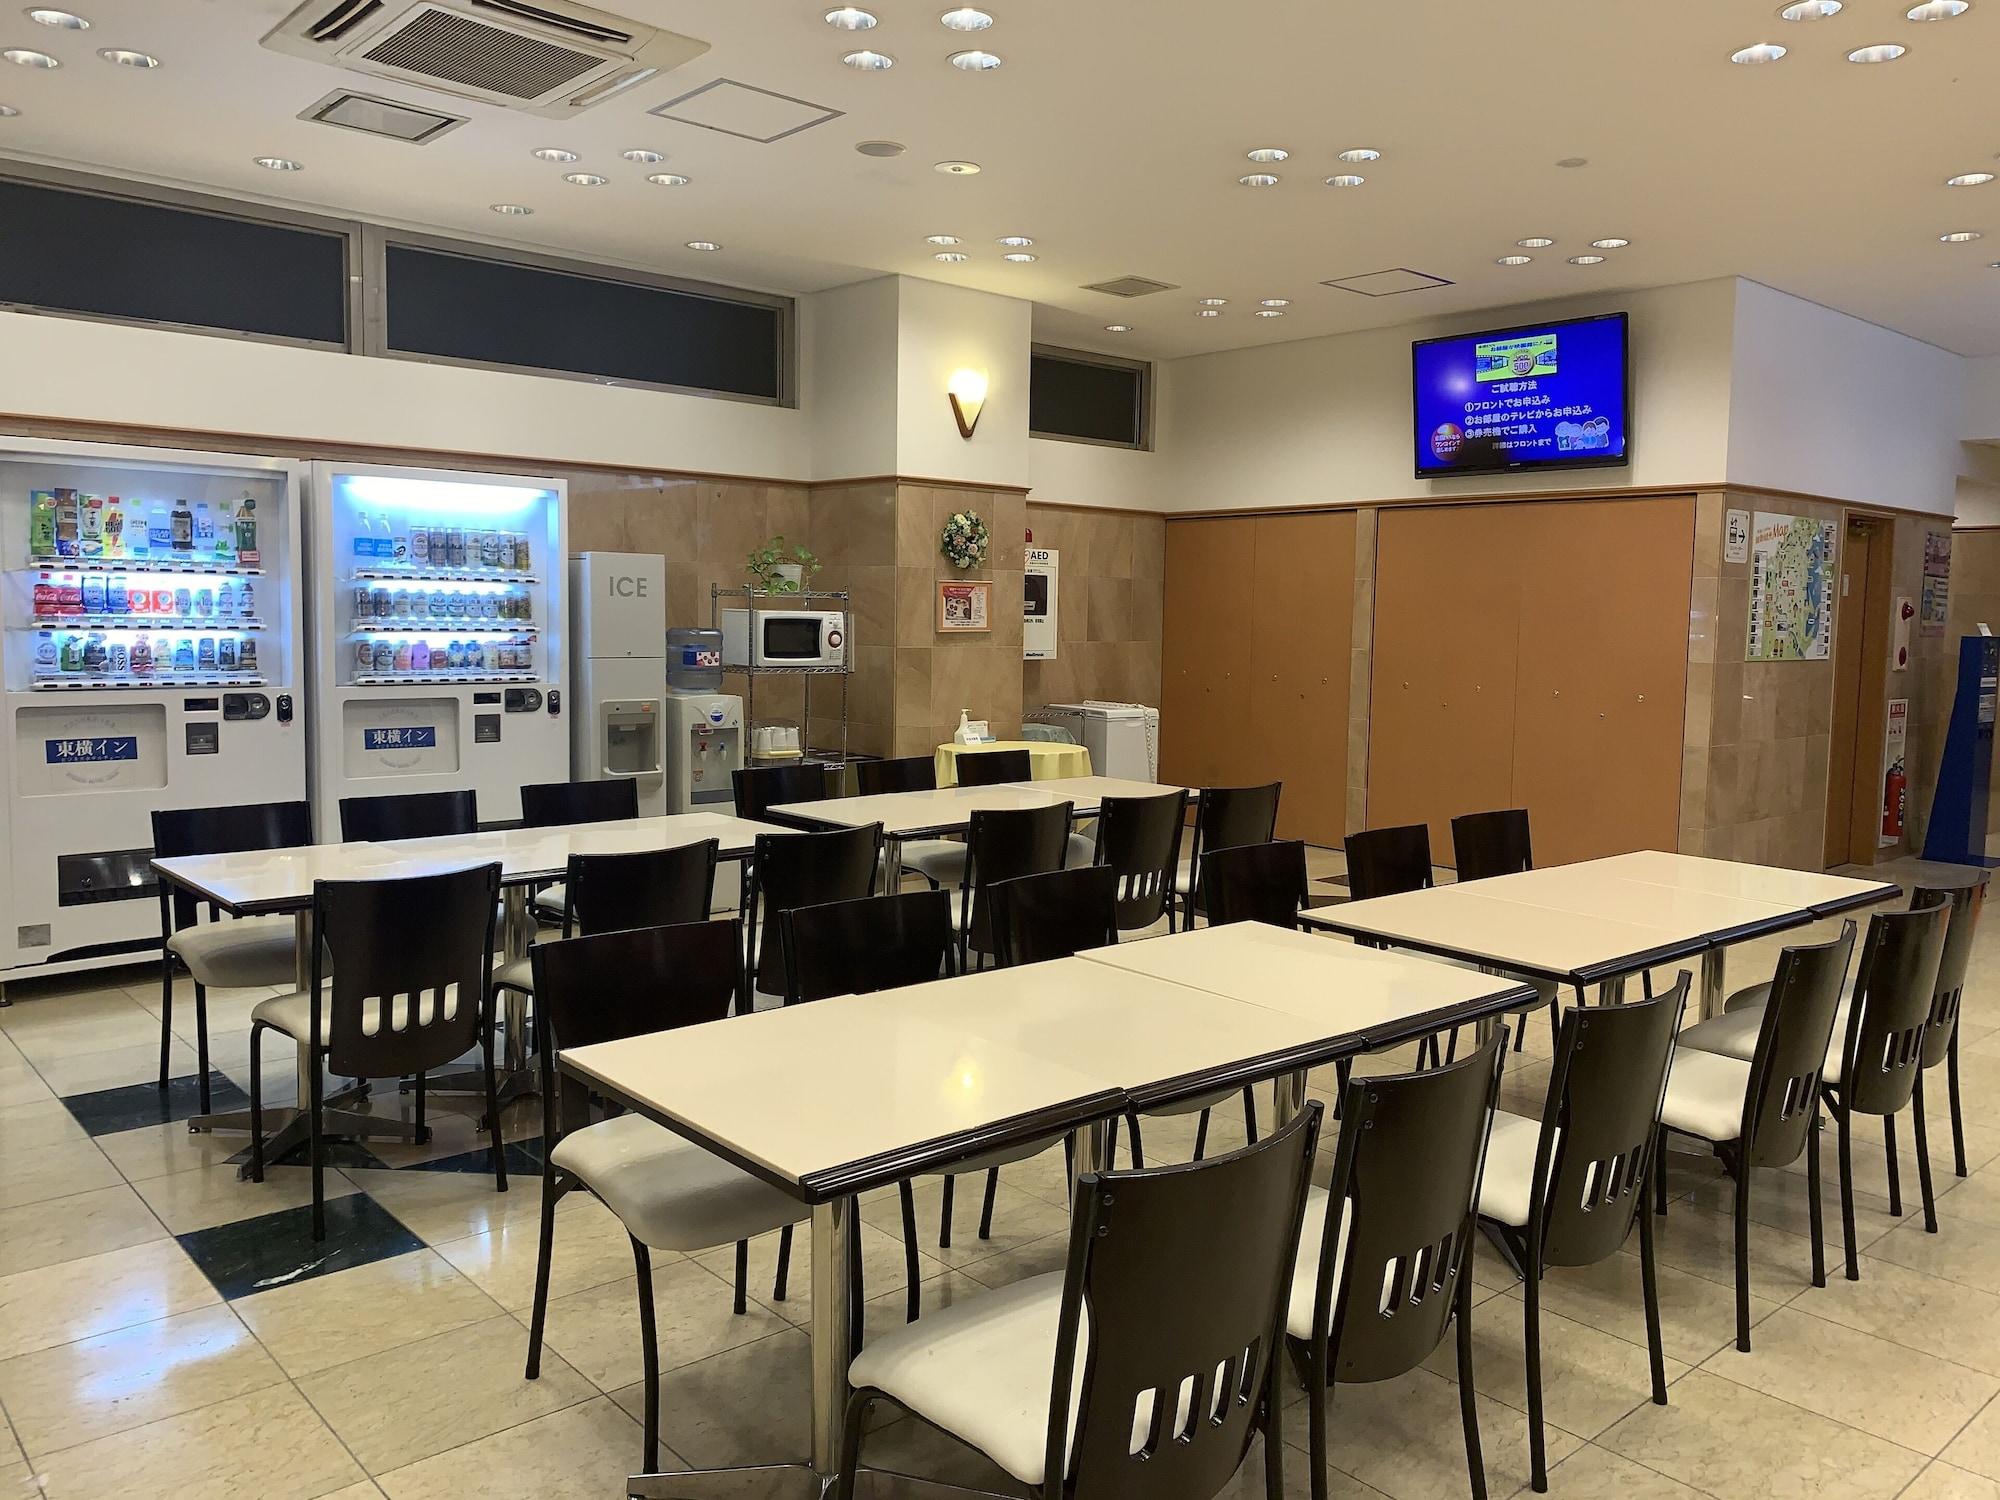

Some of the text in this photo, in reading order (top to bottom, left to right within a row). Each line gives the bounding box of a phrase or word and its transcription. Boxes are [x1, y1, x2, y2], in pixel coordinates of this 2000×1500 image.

[1514, 362, 1529, 371] 500
[1030, 552, 1049, 560] AED
[609, 576, 647, 597] ICE
[373, 729, 429, 744] 東横イン
[56, 740, 128, 757] 東横イン
